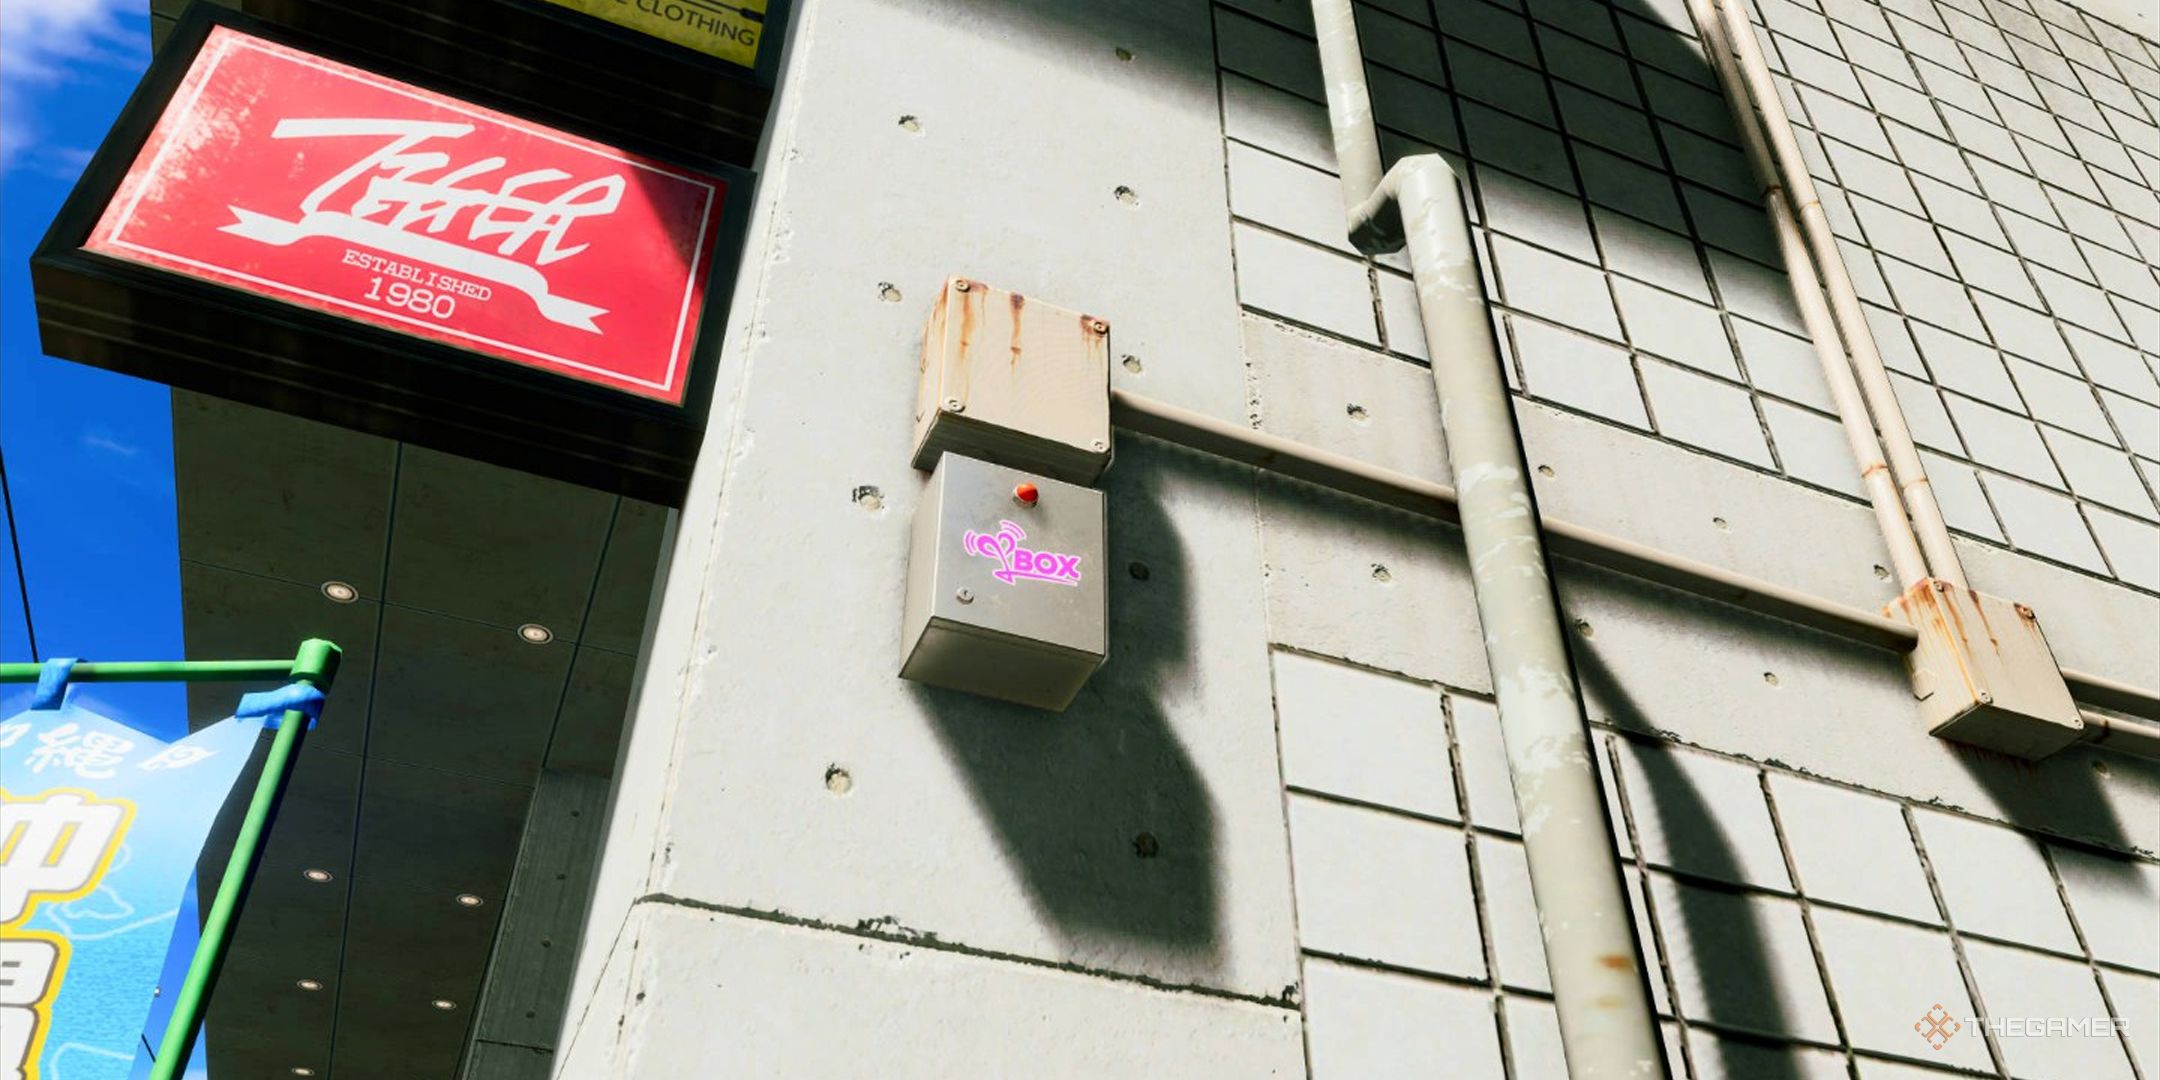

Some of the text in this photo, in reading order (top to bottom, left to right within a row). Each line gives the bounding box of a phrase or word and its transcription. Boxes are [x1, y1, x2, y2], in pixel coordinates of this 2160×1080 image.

[636, 0, 756, 47] CLOTHING
[341, 249, 493, 302] ESTABLISHED
[363, 276, 456, 319] 1980
